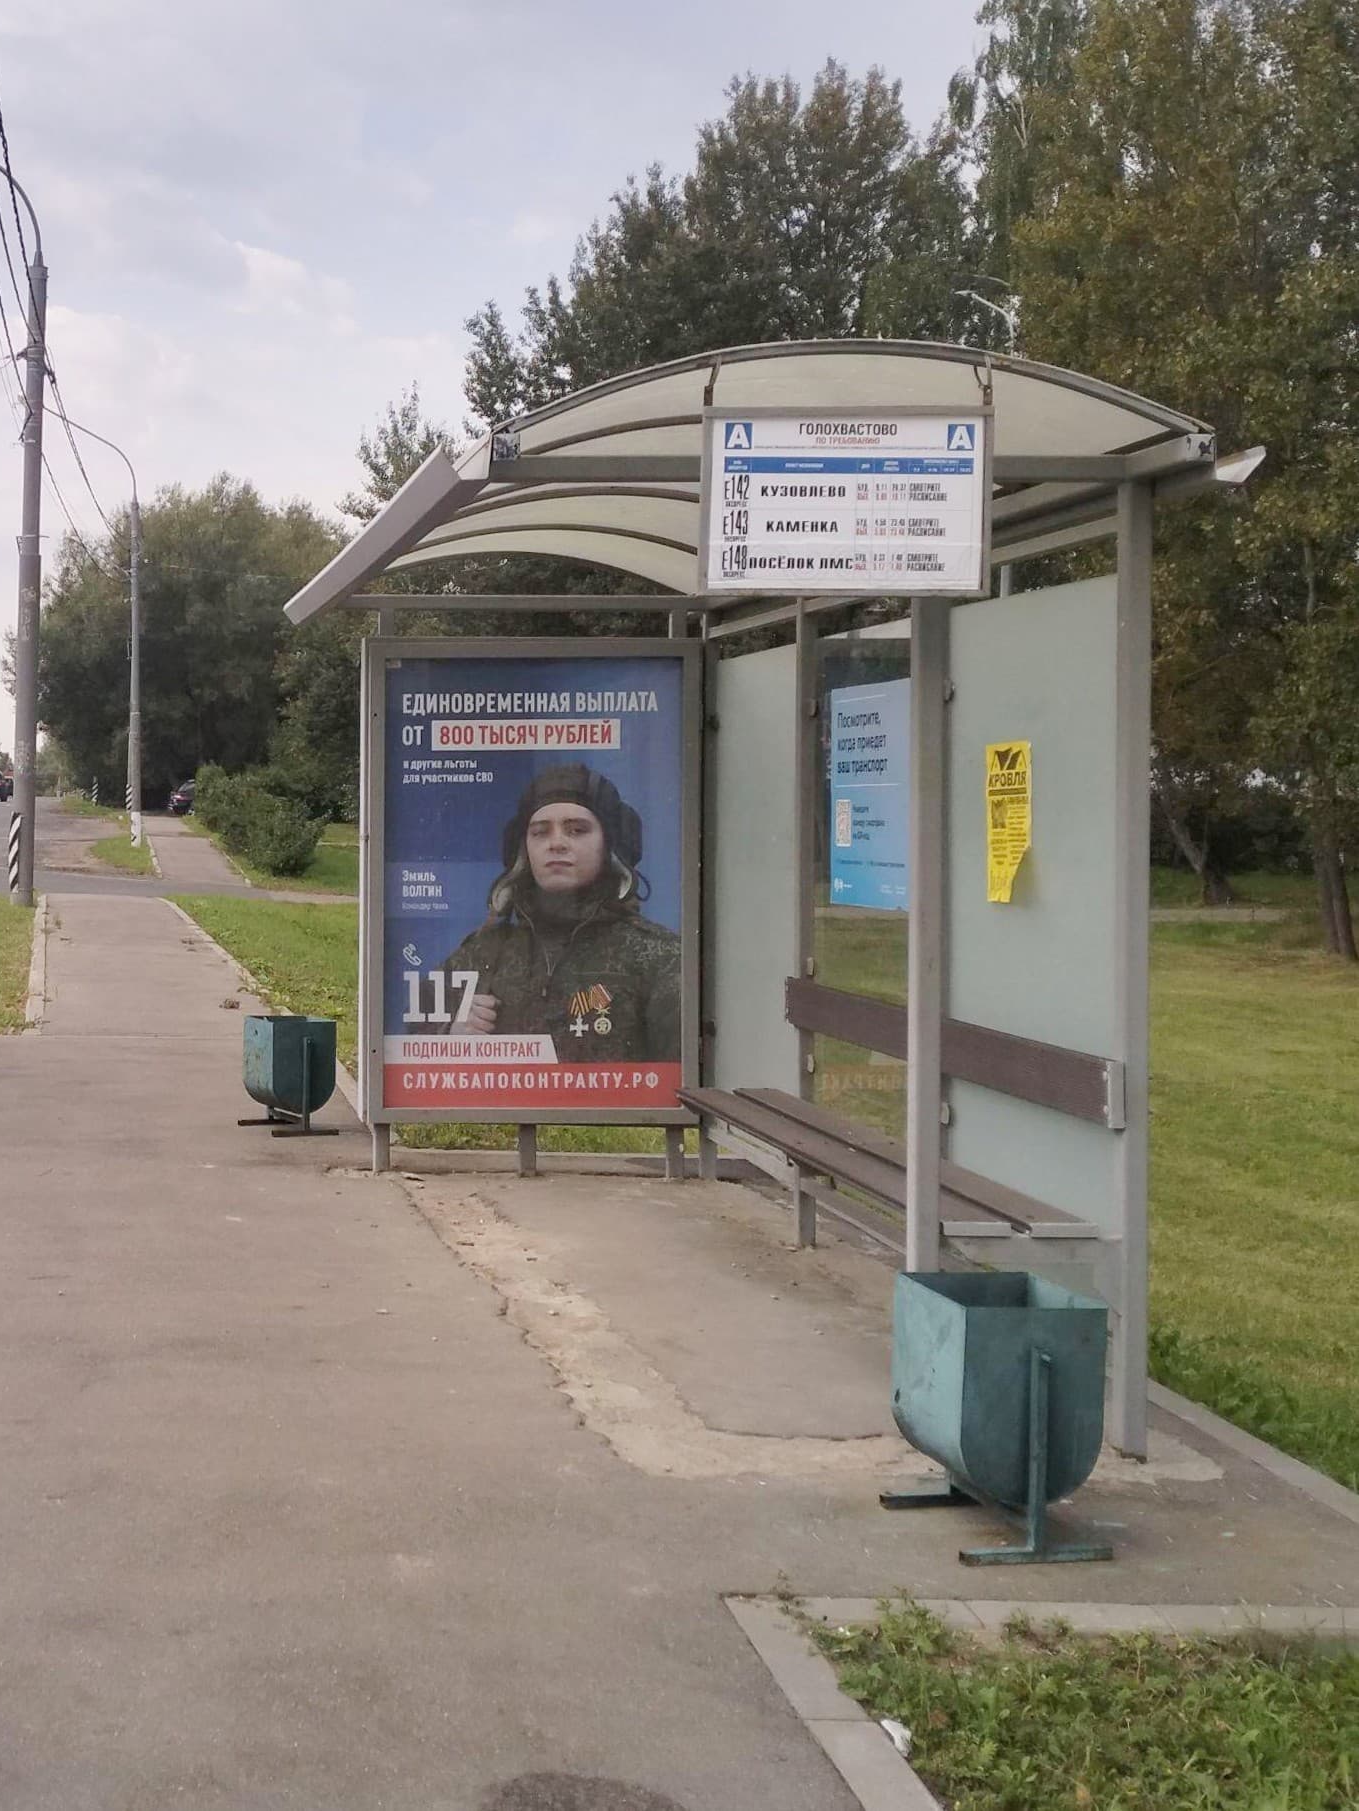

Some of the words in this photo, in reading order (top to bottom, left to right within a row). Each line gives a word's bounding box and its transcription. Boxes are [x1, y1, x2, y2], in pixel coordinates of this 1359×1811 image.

[799, 423, 898, 436] ГОЛОХВАСТОВО
[816, 436, 827, 444] ПО
[829, 436, 881, 444] ТРЕБОВАНИЮ
[761, 485, 846, 497] КУЗОВЛЕВО
[766, 521, 838, 532] КАМЕНКА
[749, 555, 814, 569] ПОСЁЛОК
[402, 691, 570, 716] ЕДИНОВРЕМЕННАЯ
[575, 690, 659, 713] ВЫПЛАТА
[402, 725, 424, 746] ОТ
[440, 725, 474, 745] 800
[478, 724, 539, 745] ТЫСЯЧ
[544, 720, 612, 745] РУБЛЕЙ
[403, 760, 409, 769] и
[410, 760, 442, 771] другие
[444, 759, 477, 769] льготы
[402, 774, 420, 784] для
[421, 774, 474, 785] участников
[475, 771, 494, 783] СВО
[988, 770, 1027, 787] КРОВЛЯ
[402, 869, 436, 882] Эмиль
[402, 884, 442, 898] ВОЛГИН
[403, 970, 479, 1023] 117
[403, 1041, 472, 1059] ПОДПИШИ
[475, 1041, 541, 1058] КОНТРАКТ
[403, 1071, 659, 1090] СЛУЖБАПОКОНТРАКТУ.РФ
